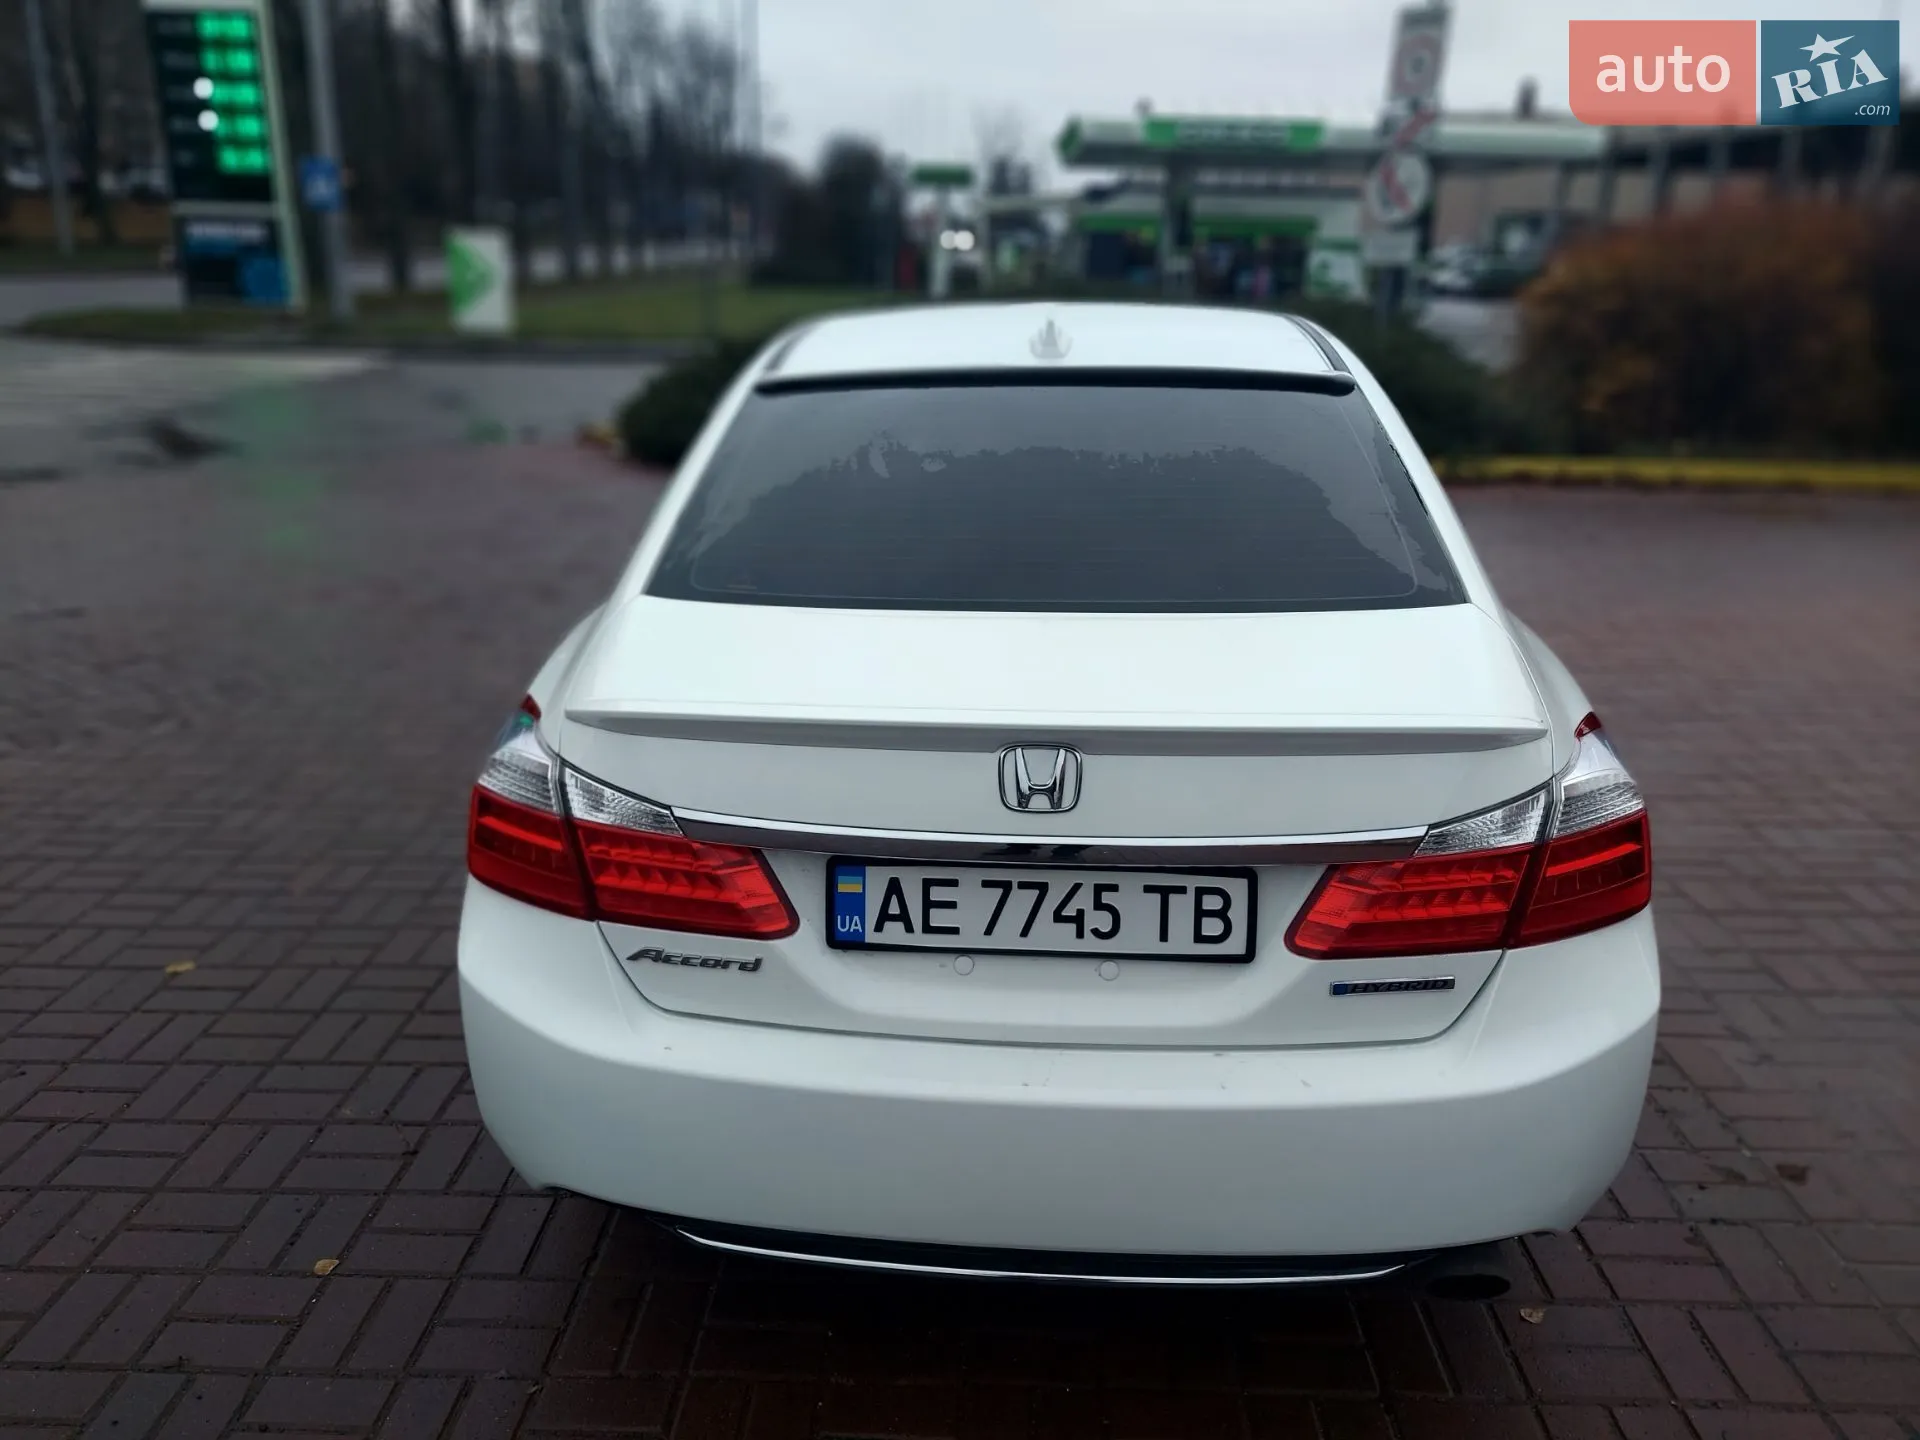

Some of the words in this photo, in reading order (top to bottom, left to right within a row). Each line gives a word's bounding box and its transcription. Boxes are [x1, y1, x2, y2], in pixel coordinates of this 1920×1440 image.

[873, 876, 960, 935] AE
[980, 881, 1121, 940] 7745
[1143, 884, 1234, 944] TB
[837, 915, 863, 934] UA
[626, 946, 763, 973] Accord
[1350, 979, 1448, 994] HYBRID
